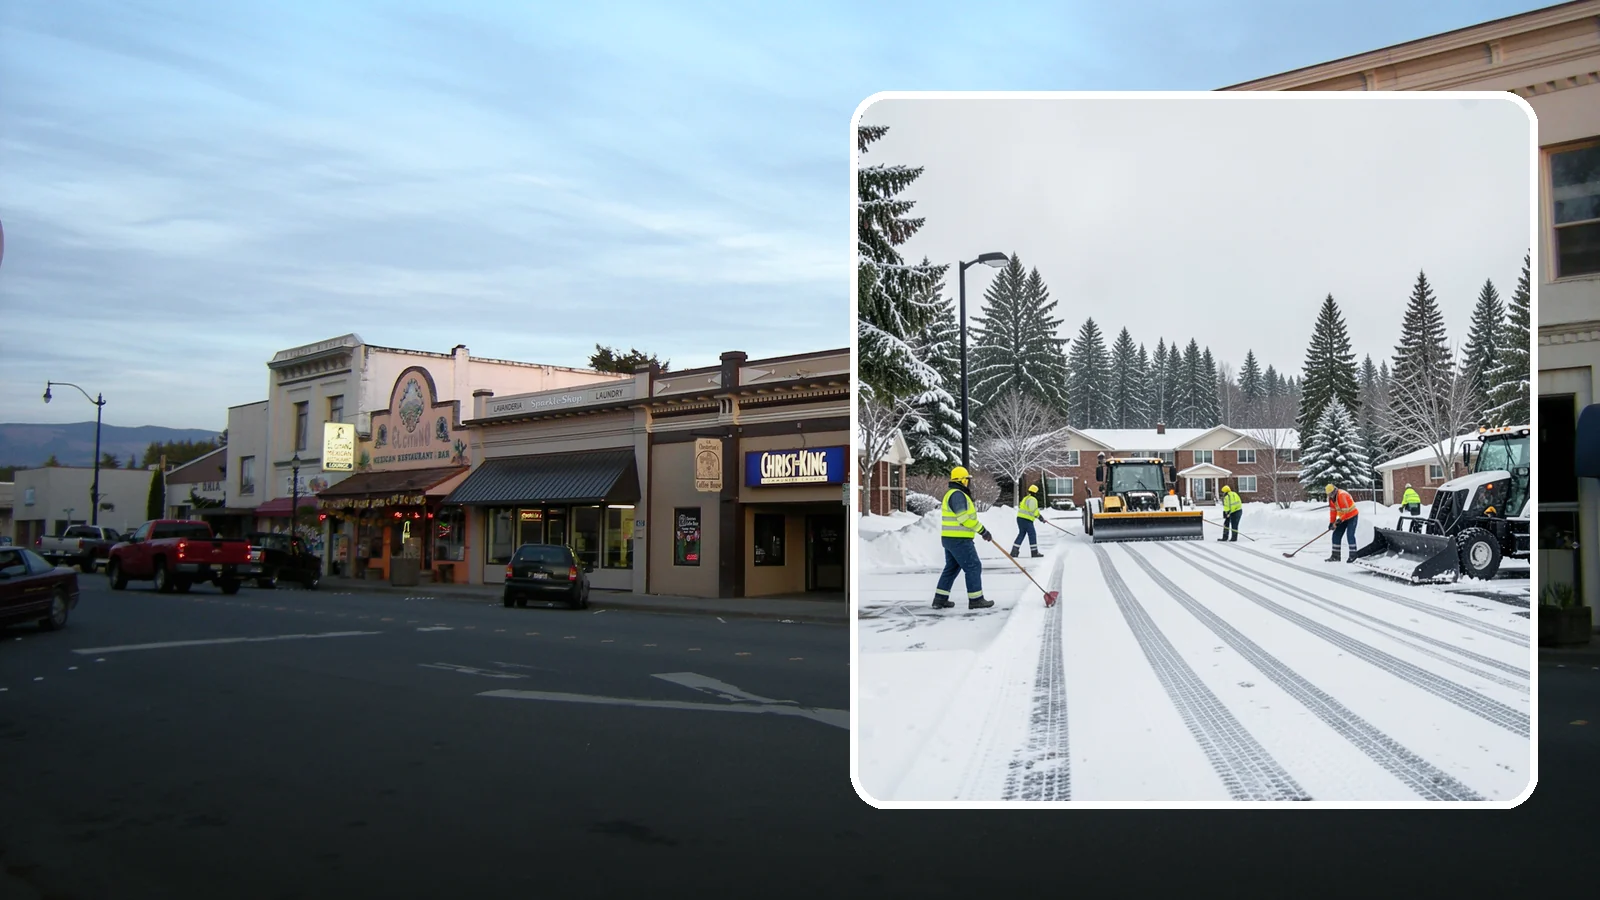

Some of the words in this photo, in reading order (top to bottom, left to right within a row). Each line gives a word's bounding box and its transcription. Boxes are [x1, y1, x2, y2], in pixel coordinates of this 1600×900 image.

[596, 388, 624, 399] LAUNDRY
[493, 402, 522, 413] LAVANDERIA
[530, 397, 561, 410] Sparkle
[561, 394, 582, 405] Shop
[327, 449, 352, 457] MEXICAN
[373, 454, 397, 464] MEXICAN
[397, 451, 434, 462] RESTAURANT
[438, 449, 450, 459] BAR
[761, 452, 797, 477] CHRIST
[799, 449, 827, 476] KING
